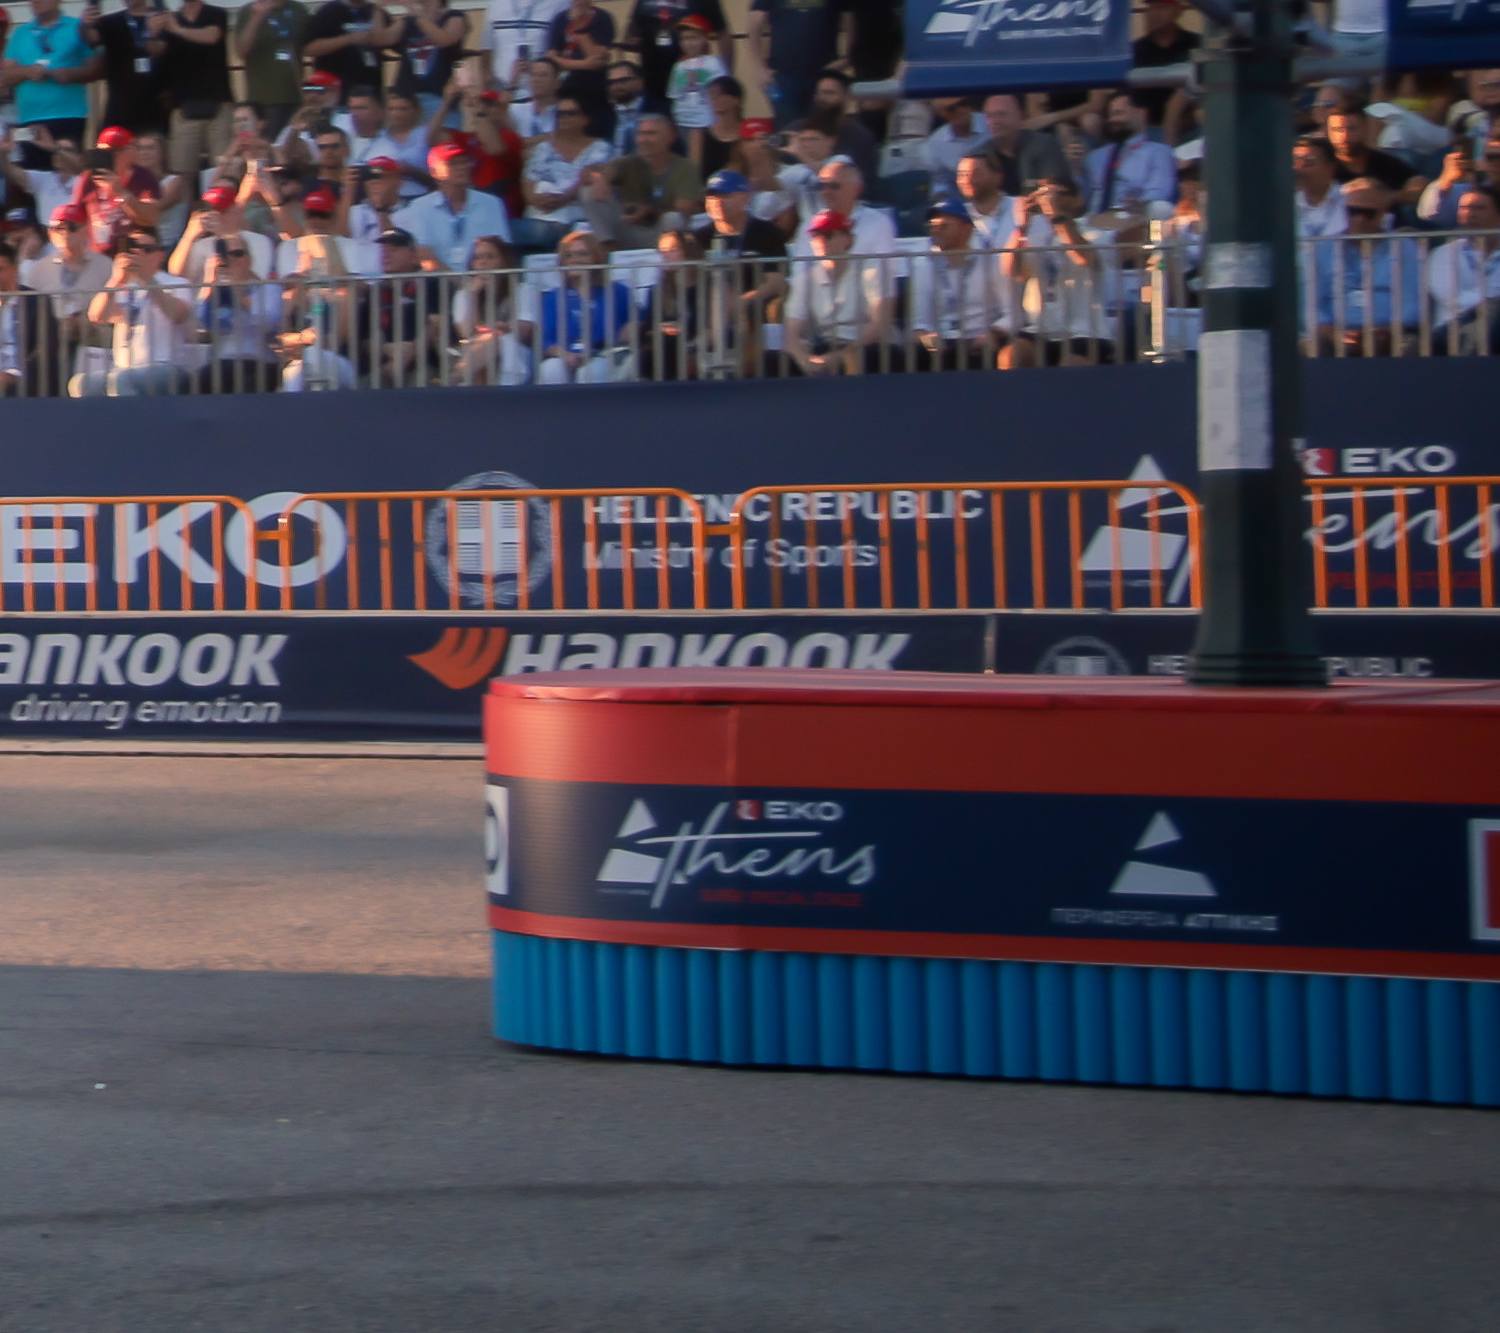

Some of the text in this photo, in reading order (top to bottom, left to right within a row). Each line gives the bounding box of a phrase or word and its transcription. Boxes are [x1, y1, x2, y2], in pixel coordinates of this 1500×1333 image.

[1341, 445, 1457, 473] EKO
[583, 489, 984, 523] HELLENC REPUBLIC
[11, 693, 281, 730] driving emotion
[763, 800, 844, 821] EKO
